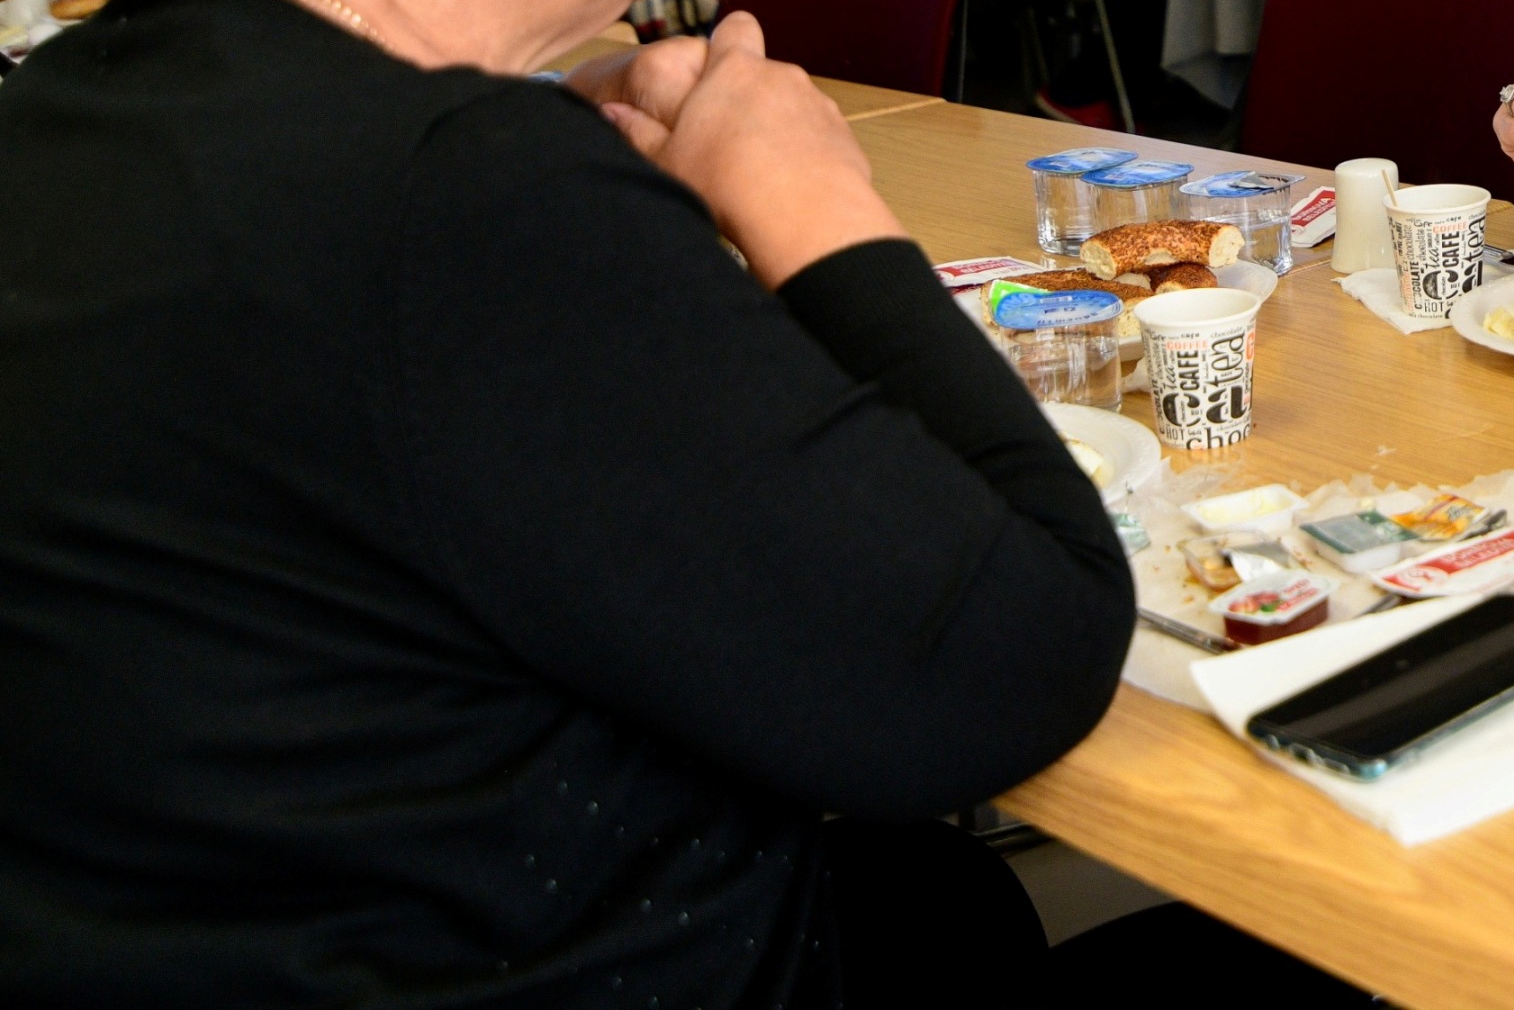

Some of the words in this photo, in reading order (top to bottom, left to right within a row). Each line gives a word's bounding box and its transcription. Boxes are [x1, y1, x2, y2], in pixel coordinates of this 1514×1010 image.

[1432, 222, 1468, 234] COFFEE
[1424, 247, 1440, 269] tea
[1441, 231, 1460, 268] CAFE
[1424, 301, 1444, 313] HOT
[1166, 340, 1208, 351] COFFEE
[1205, 332, 1246, 388] tea
[1176, 349, 1200, 392] CAFE
[1165, 426, 1185, 441] HOT
